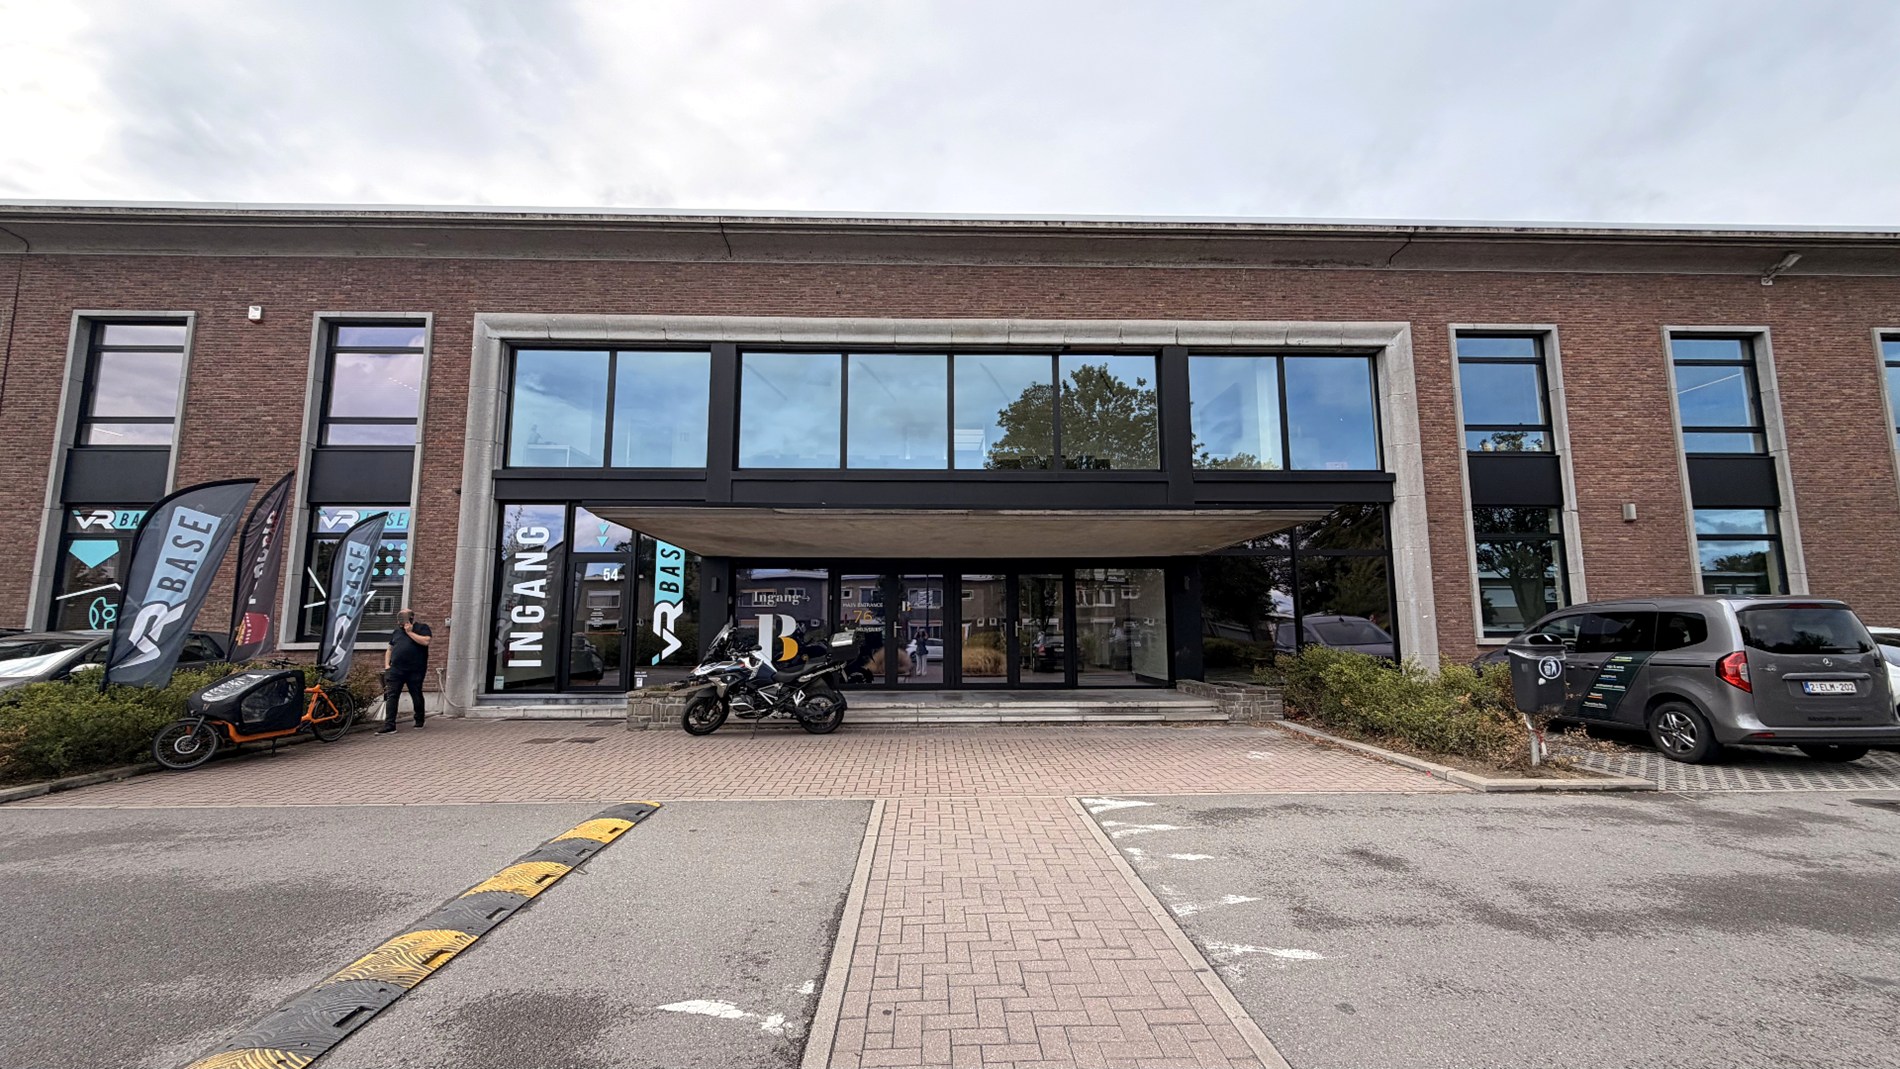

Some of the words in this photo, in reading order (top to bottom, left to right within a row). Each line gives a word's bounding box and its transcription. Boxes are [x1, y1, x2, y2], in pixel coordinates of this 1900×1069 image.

[156, 514, 214, 594] BASE
[603, 567, 619, 581] 54
[658, 547, 682, 594] BAS
[507, 526, 550, 667] INGANG
[754, 591, 801, 606] Ingang
[853, 610, 873, 624] 76
